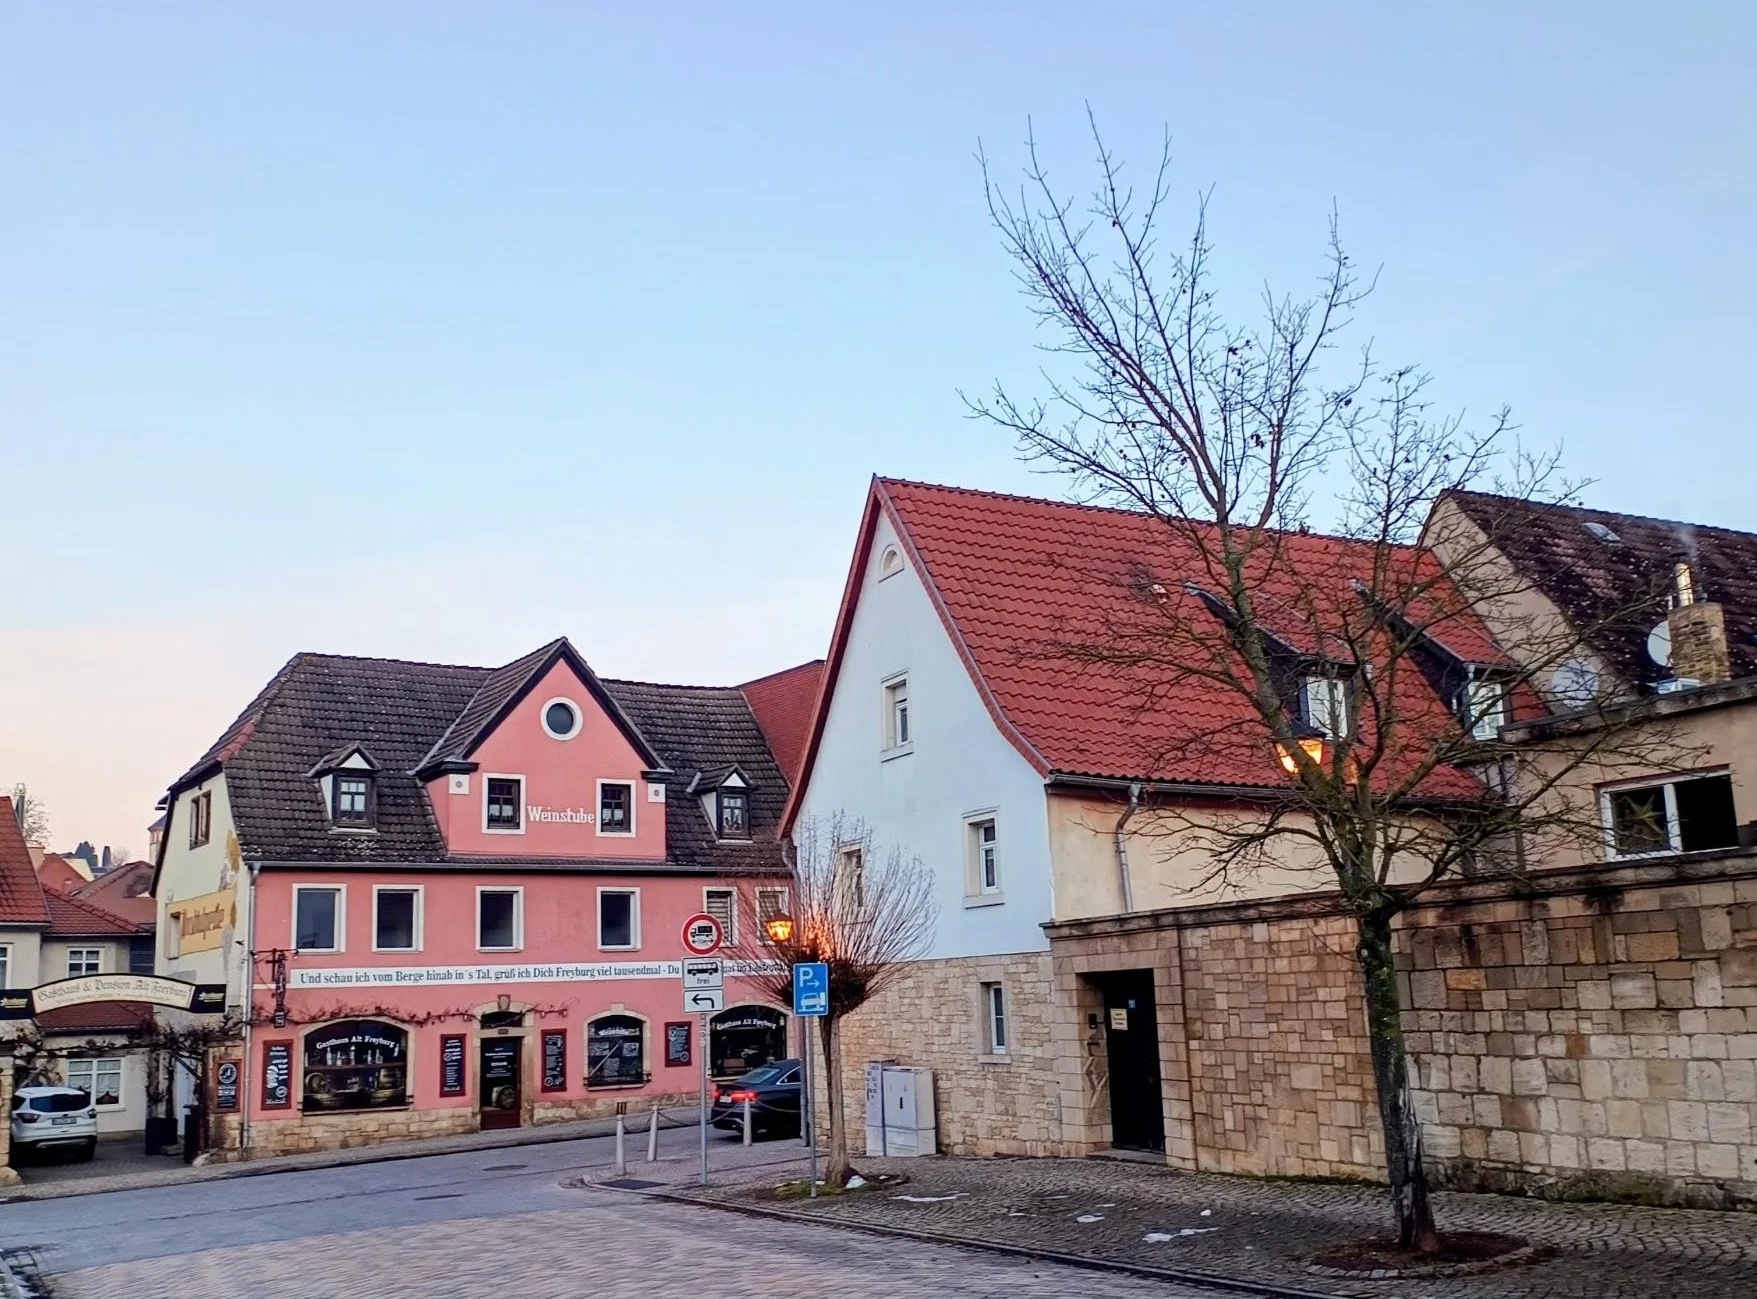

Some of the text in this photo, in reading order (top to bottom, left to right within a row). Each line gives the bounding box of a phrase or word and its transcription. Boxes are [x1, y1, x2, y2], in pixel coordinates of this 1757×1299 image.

[527, 805, 595, 823] Weinstube
[300, 972, 321, 984] Und
[324, 972, 353, 983] schau
[355, 971, 370, 983] ich
[373, 973, 393, 982] vom
[396, 970, 424, 983] Berge
[426, 969, 453, 981] hinab
[517, 968, 531, 979] ich
[533, 967, 554, 978] Dich
[556, 965, 596, 979] Freyburg
[597, 965, 612, 976] viel
[614, 964, 661, 976] tausendmal
[668, 964, 680, 975] Du
[697, 977, 710, 985] frei
[800, 967, 813, 988] P
[316, 1035, 396, 1050] Gasthaus Alt Freyburg
